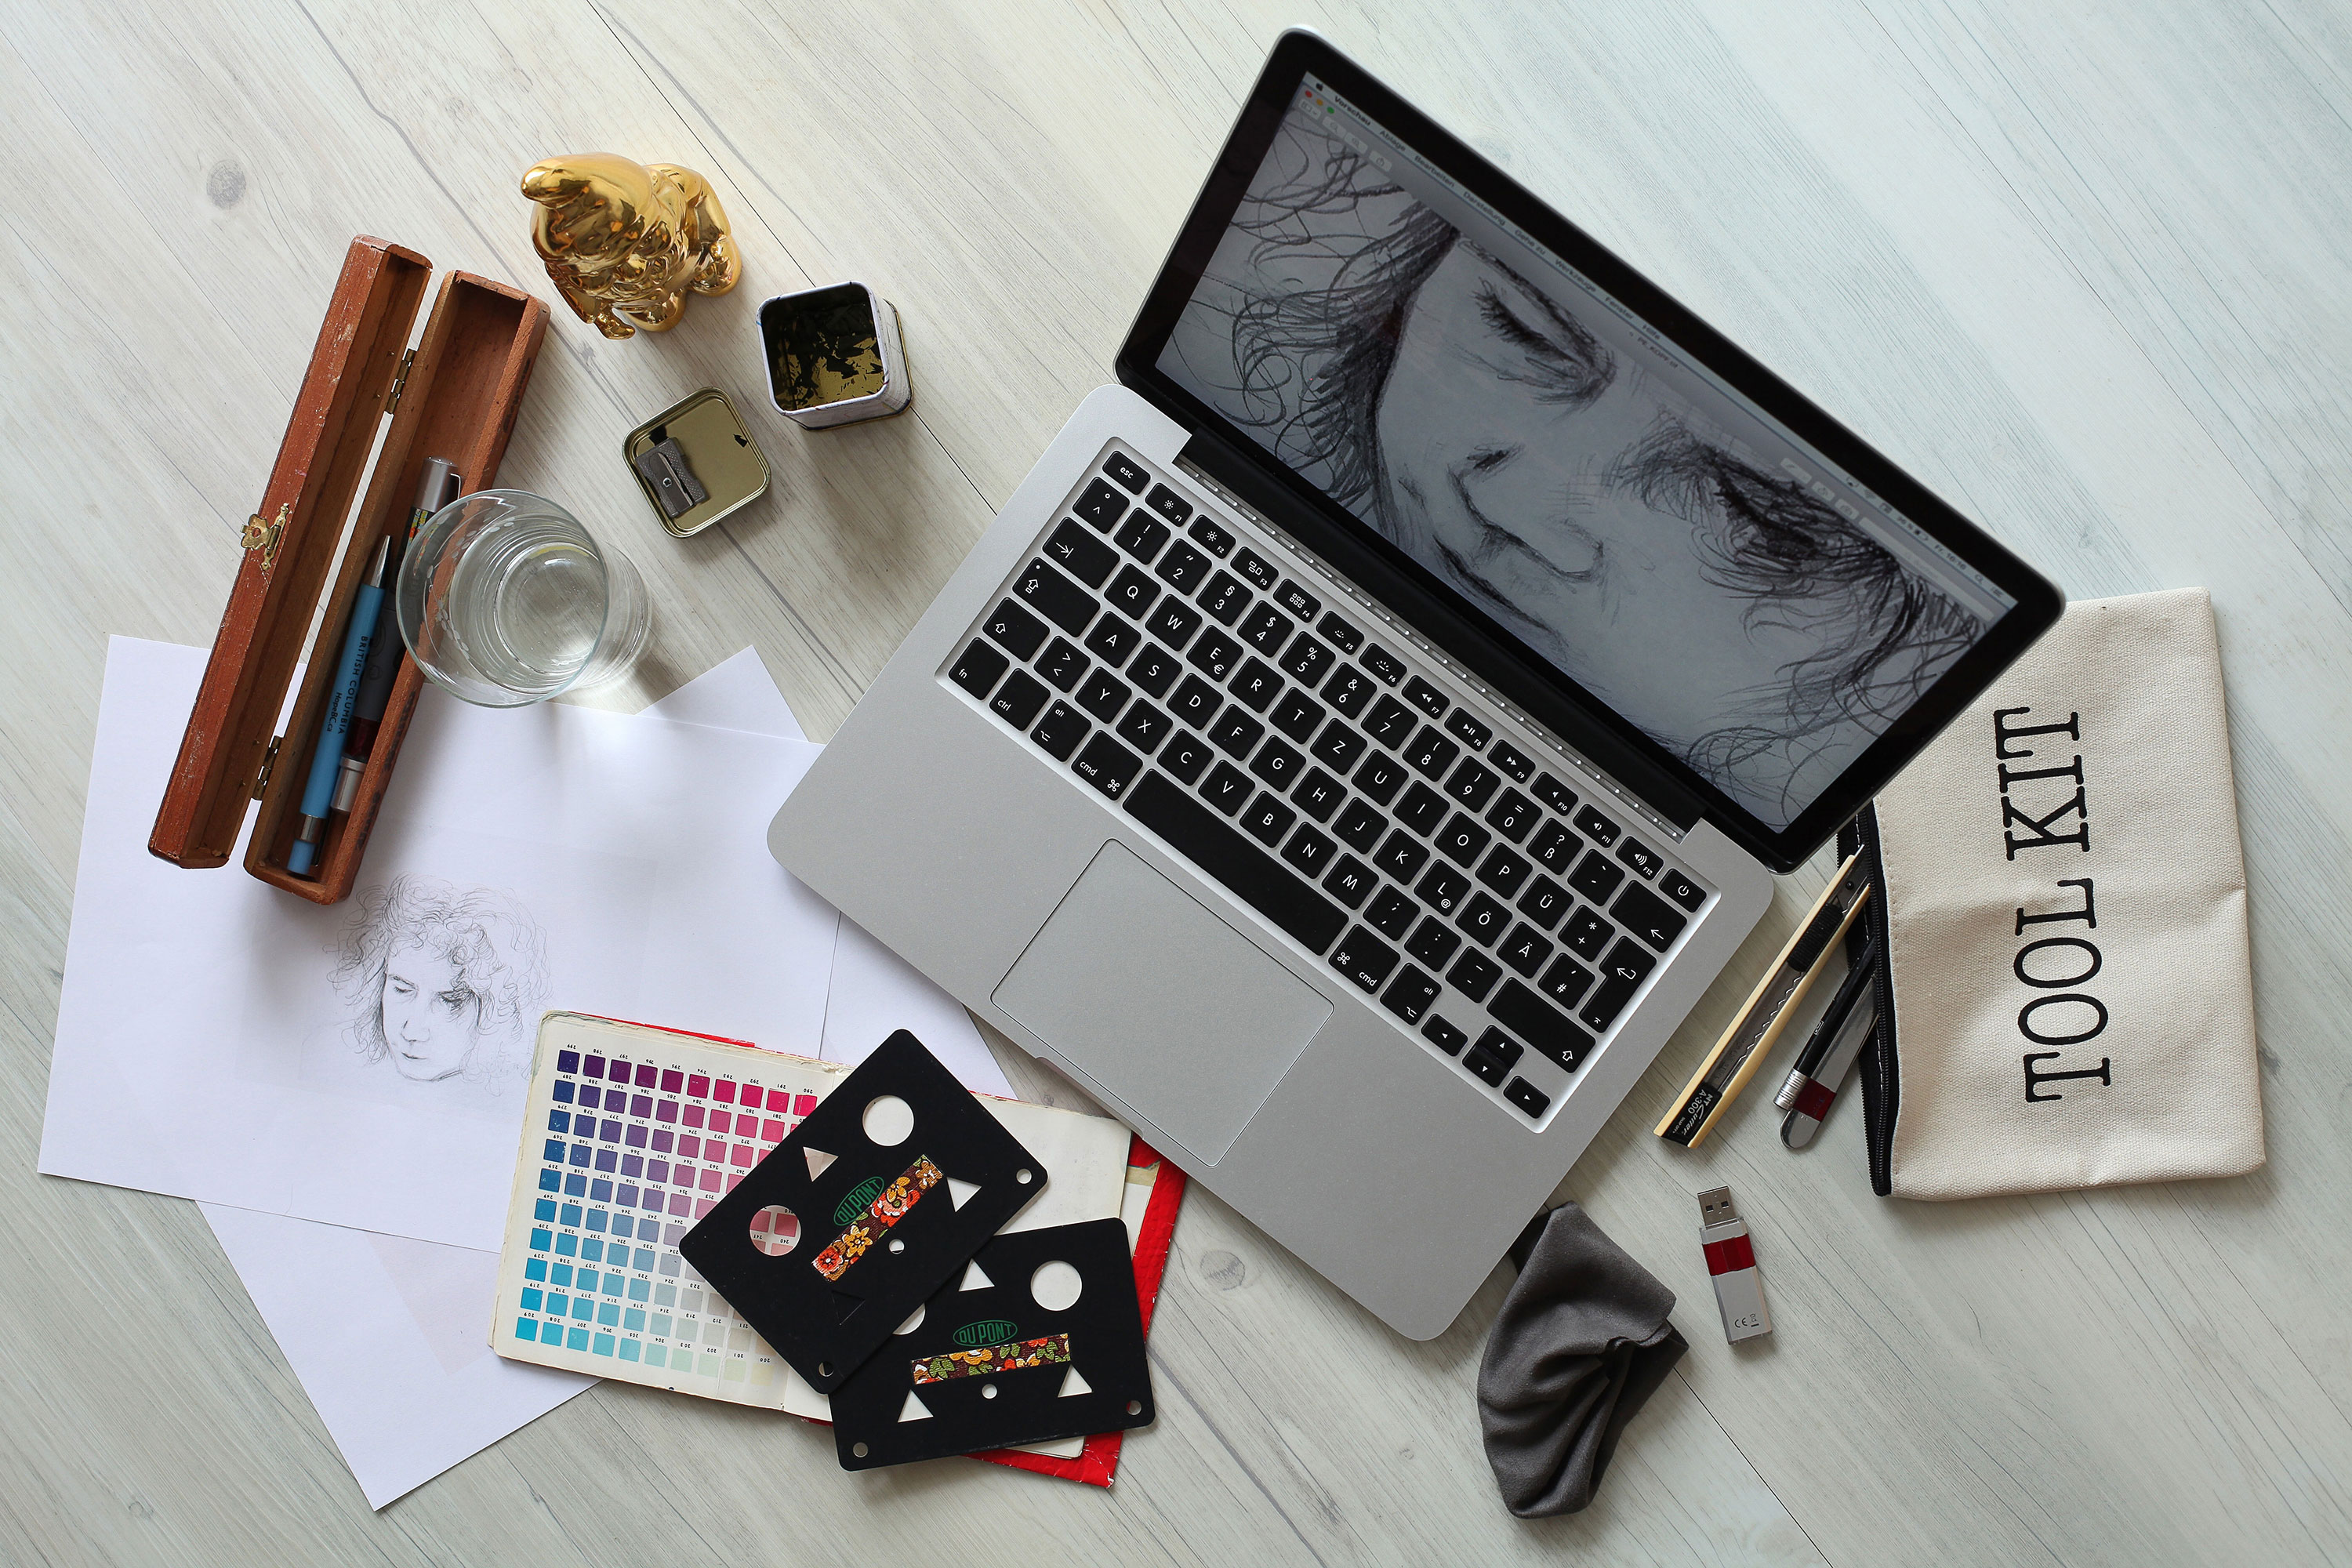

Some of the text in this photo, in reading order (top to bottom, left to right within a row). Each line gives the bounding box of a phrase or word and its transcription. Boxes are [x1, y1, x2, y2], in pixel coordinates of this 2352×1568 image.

[1334, 96, 1371, 126] Vorschau
[1379, 129, 1406, 152] Ablage
[1414, 155, 1455, 188] Bearbeiten
[1463, 191, 1506, 227] Darstellung
[1555, 259, 1596, 293] Werkzeuge
[1606, 296, 1634, 320] Fenster
[1120, 466, 1134, 479] esc
[1133, 536, 1142, 548] 1
[1172, 568, 1184, 580] 2
[1127, 585, 1138, 600] Q
[1225, 585, 1236, 597] §
[1214, 598, 1225, 610] 3
[1167, 614, 1183, 630] W
[1265, 616, 1276, 627] $
[1105, 634, 1117, 648] A
[1256, 631, 1267, 641] 4
[1345, 642, 1354, 651] F5
[1210, 647, 1221, 660] E
[1308, 647, 1318, 660] %
[958, 668, 967, 679] fn
[1148, 664, 1160, 677] S
[1214, 663, 1225, 675] €
[1297, 661, 1308, 673] 5
[338, 635, 368, 735] BRITISH COLUMBIA
[1250, 678, 1262, 692] R
[1348, 678, 1358, 691] &
[1388, 674, 1396, 683] F6
[1099, 688, 1111, 701] Y
[1189, 694, 1201, 708] D
[1338, 693, 1348, 703] 6
[326, 691, 343, 732] HopeBC.ca
[997, 699, 1011, 711] ctrl
[1054, 709, 1065, 717] alt
[1294, 709, 1305, 721] T
[1137, 719, 1152, 734] X
[1231, 726, 1243, 737] F
[1379, 721, 1391, 733] 7
[1332, 739, 1346, 754] Z
[1180, 751, 1192, 764] C
[1272, 757, 1284, 770] G
[1421, 753, 1432, 765] 8
[1080, 761, 1098, 776] cmd
[1374, 770, 1388, 785] U
[1222, 780, 1234, 793] V
[1462, 785, 1473, 795] 9
[1312, 786, 1327, 802] H
[1557, 801, 1568, 811] F10
[1262, 812, 1274, 826] B
[1556, 834, 1565, 844] ?
[1601, 834, 1611, 844] F11
[1302, 843, 1317, 858] N
[1395, 850, 1409, 865] K
[1498, 865, 1510, 876] P
[1642, 866, 1653, 877] F12
[1341, 874, 1358, 891] M
[1437, 881, 1446, 895] L
[1440, 898, 1451, 909] @
[1539, 894, 1553, 909] Ü
[1993, 706, 2111, 1103] TOOL KIT
[1478, 910, 1490, 925] Ö
[1518, 942, 1533, 958] Ä
[1359, 971, 1377, 987] cmd
[1424, 987, 1434, 996] alt
[1556, 983, 1567, 993] #
[1704, 1093, 1714, 1106] NT
[837, 1178, 881, 1223] DU PONT
[1733, 1317, 1749, 1328] CE
[958, 1323, 1013, 1345] DU PONT
